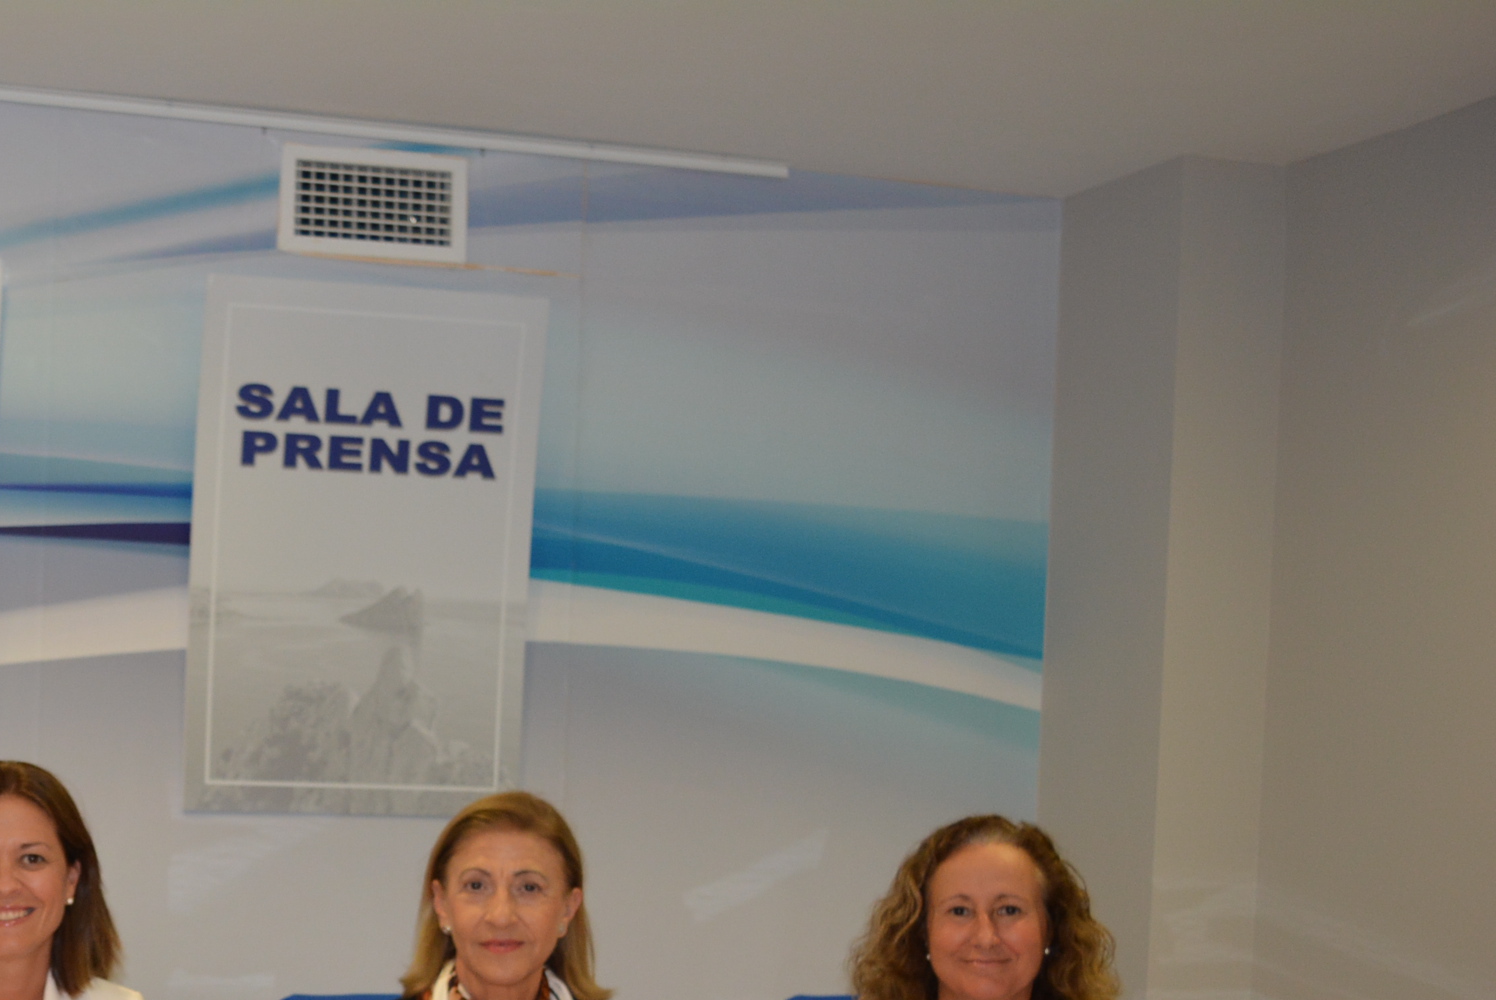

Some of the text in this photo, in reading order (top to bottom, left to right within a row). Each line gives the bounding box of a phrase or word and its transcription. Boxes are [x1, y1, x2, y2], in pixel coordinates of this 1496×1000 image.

[235, 383, 506, 434] SALA DE
[240, 430, 497, 481] PRENSA
